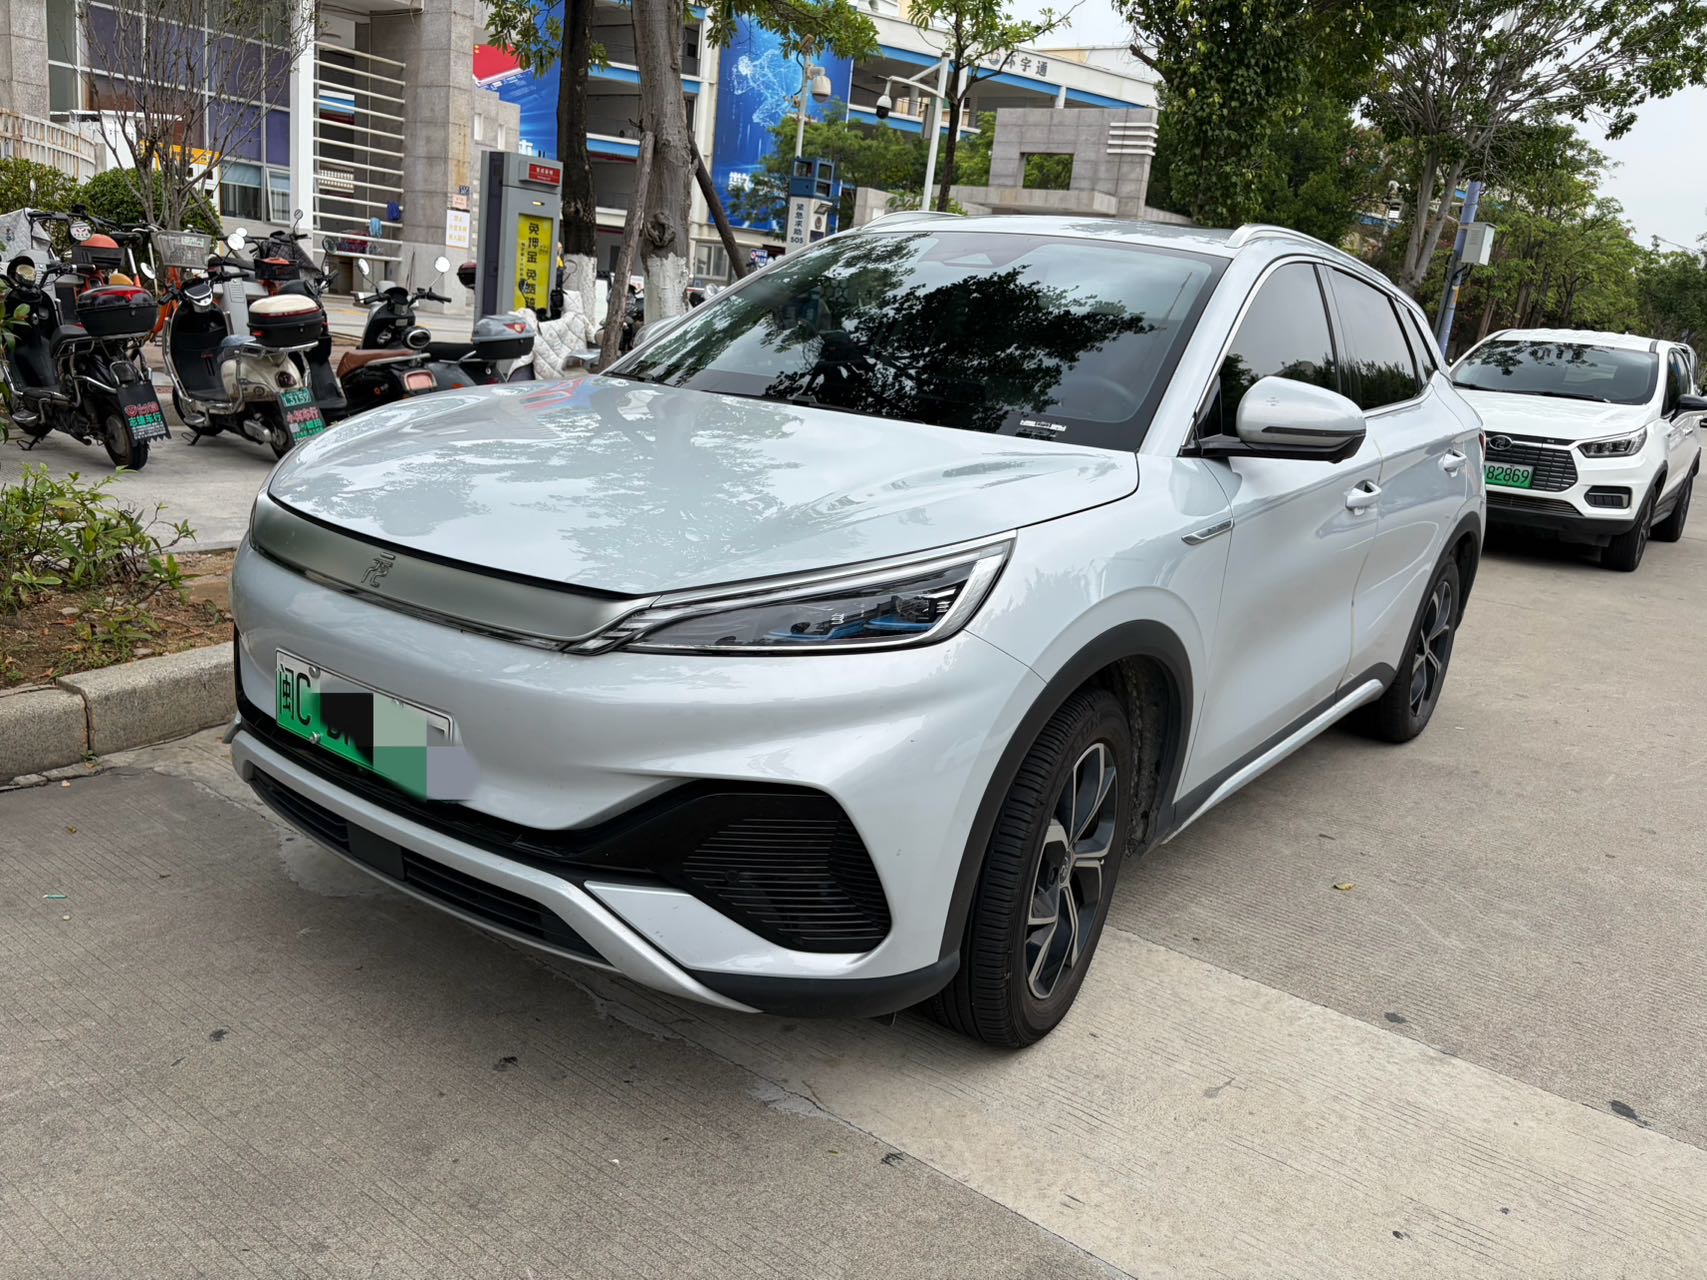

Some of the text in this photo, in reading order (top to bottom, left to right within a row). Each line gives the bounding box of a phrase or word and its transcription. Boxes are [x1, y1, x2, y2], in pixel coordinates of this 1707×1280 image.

[793, 203, 804, 236] 紧急求助
[526, 222, 540, 264] 免押金
[1485, 464, 1530, 484] 82869
